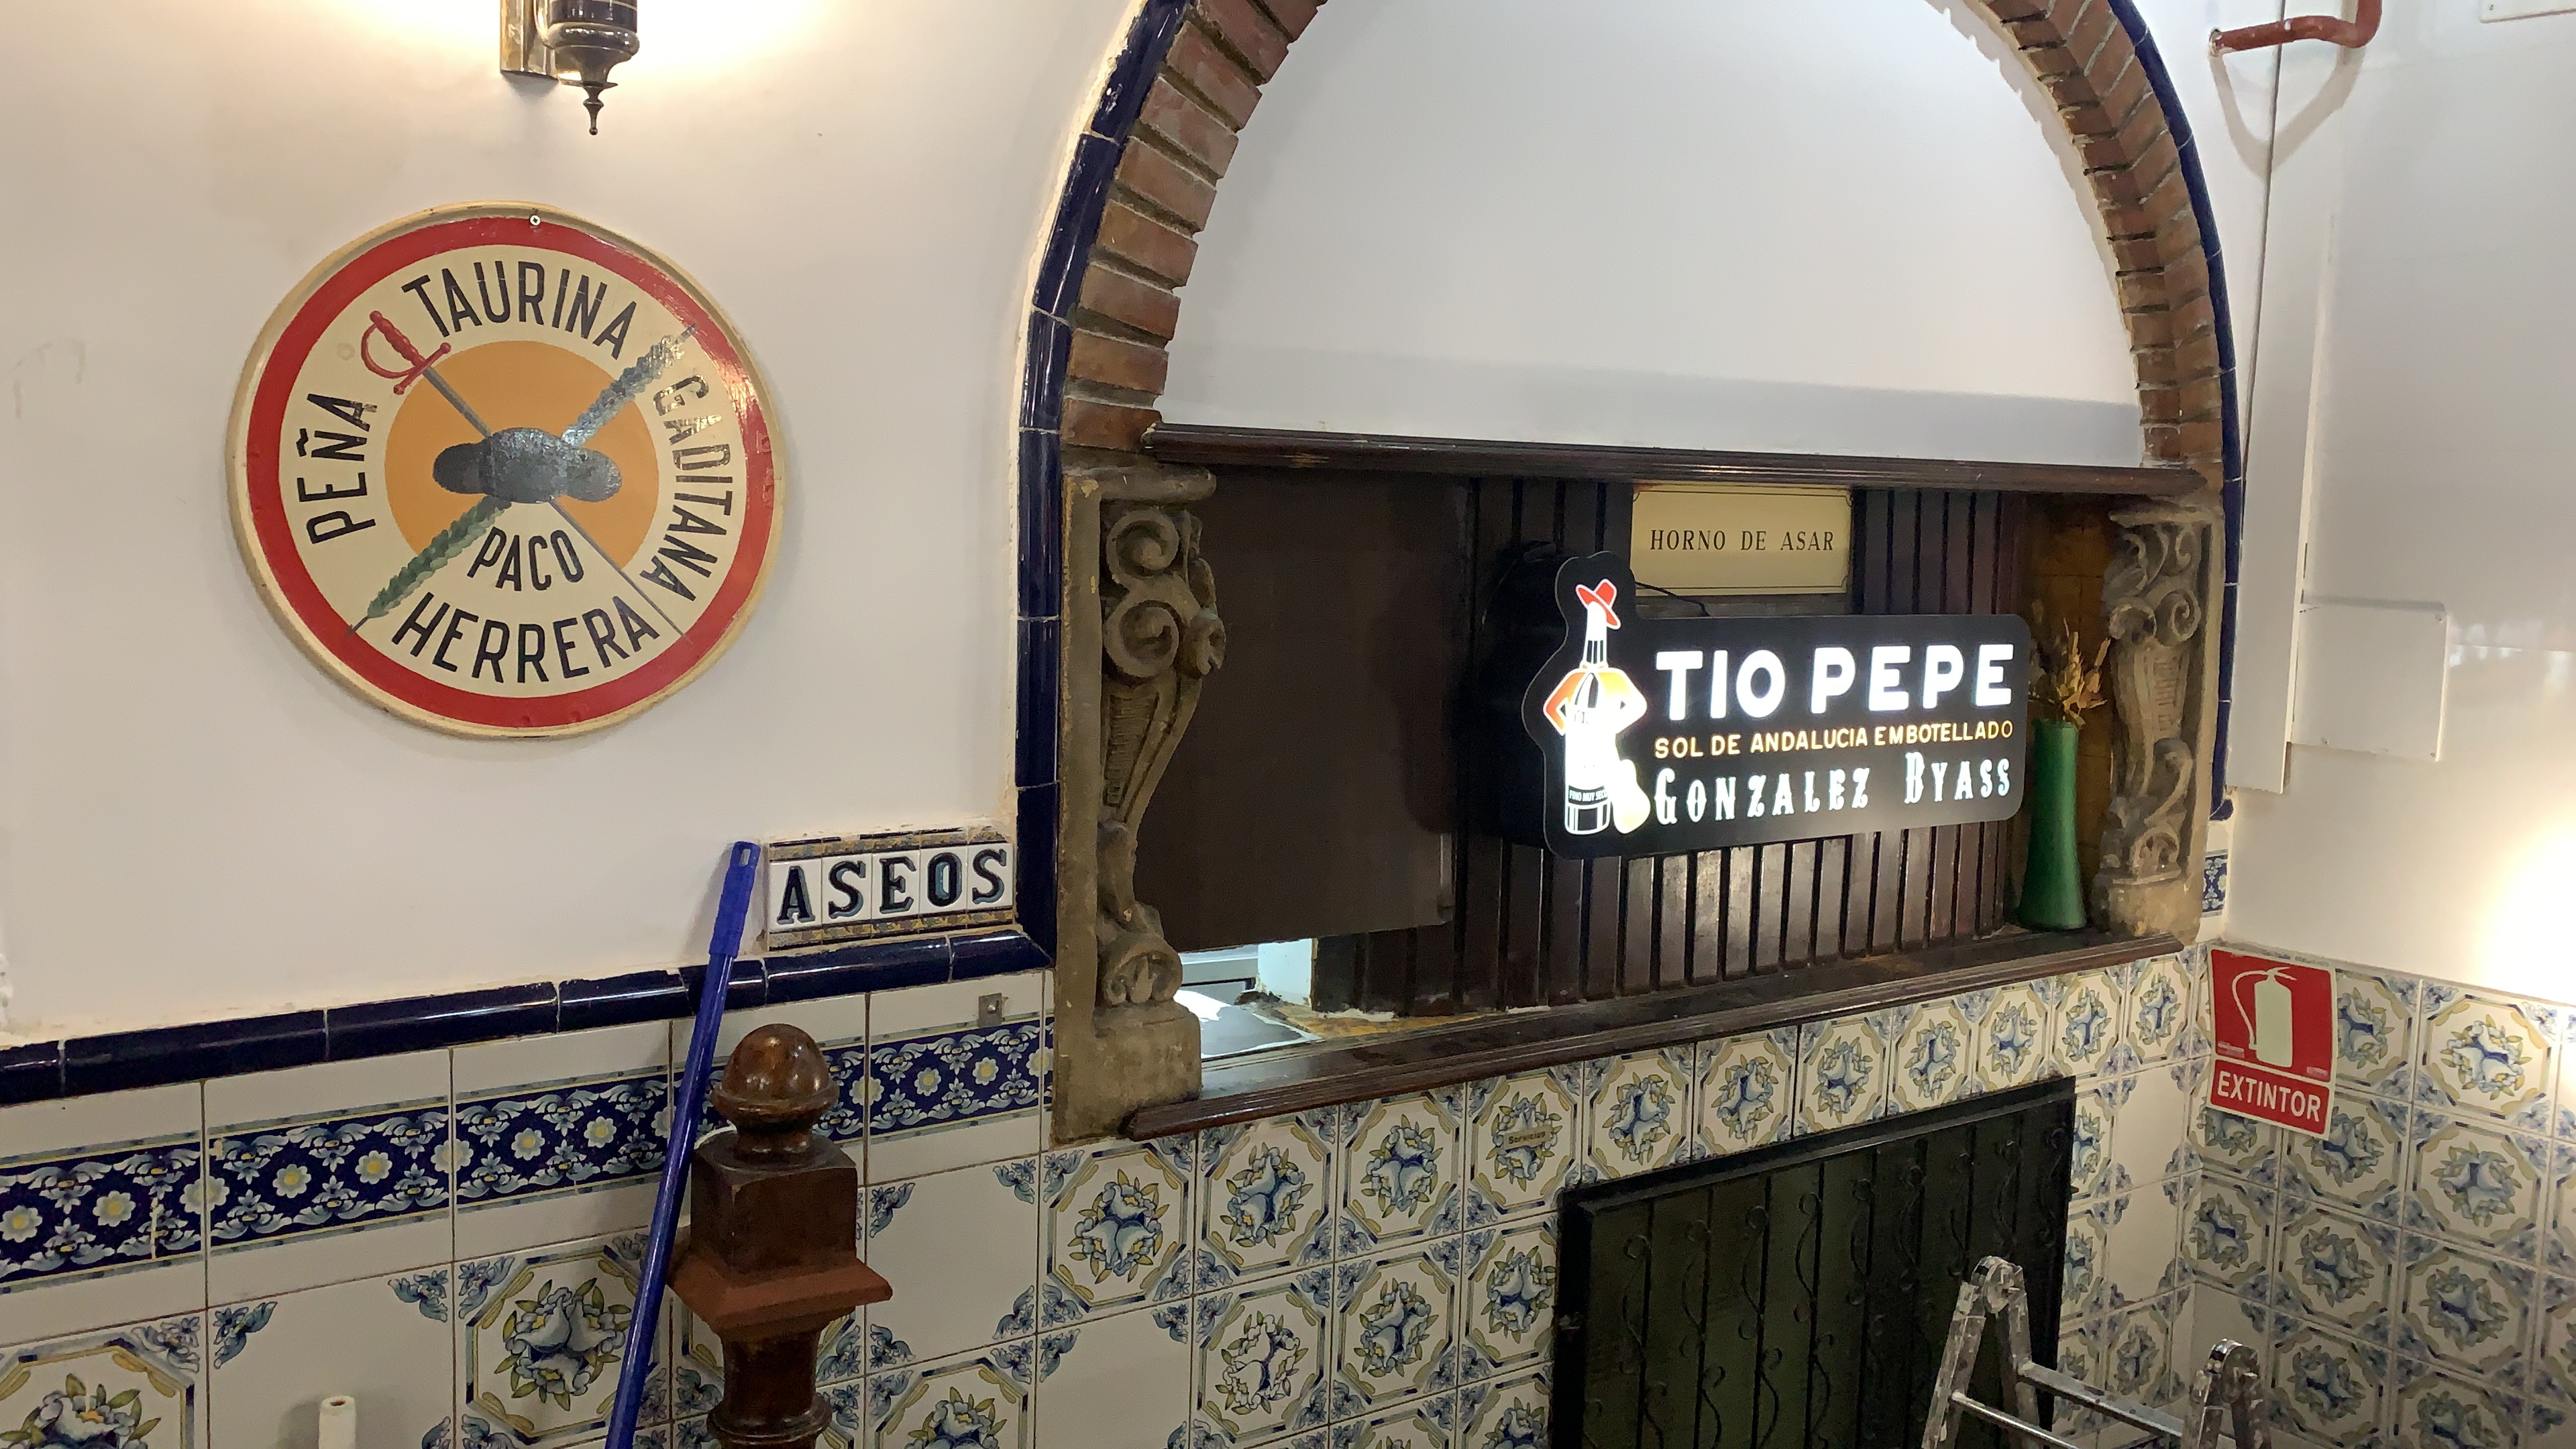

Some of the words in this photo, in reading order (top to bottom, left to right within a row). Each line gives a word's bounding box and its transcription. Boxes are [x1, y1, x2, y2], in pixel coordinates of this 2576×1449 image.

[296, 393, 378, 544] PEÑA
[401, 260, 637, 360] TAURINA
[640, 374, 733, 602] GADITANA
[467, 527, 584, 592] PACO
[1650, 529, 1725, 550] HORNO
[1741, 531, 1767, 551] DE
[1780, 531, 1834, 551] ASAR
[391, 591, 661, 684] HERRERA
[1655, 649, 1786, 721] TIO
[1811, 643, 2014, 714] PEPE
[1654, 734, 1704, 759] SOL
[1711, 734, 1741, 755] DE
[1750, 726, 1868, 754] ANDALUCIA
[1874, 720, 2014, 746] EMBOTELLADO
[1653, 766, 1870, 826] GONZALEZ
[1904, 751, 2010, 805] BYASS
[776, 849, 1007, 925] ASEOS
[2217, 1070, 2321, 1122] EXTINTOR
